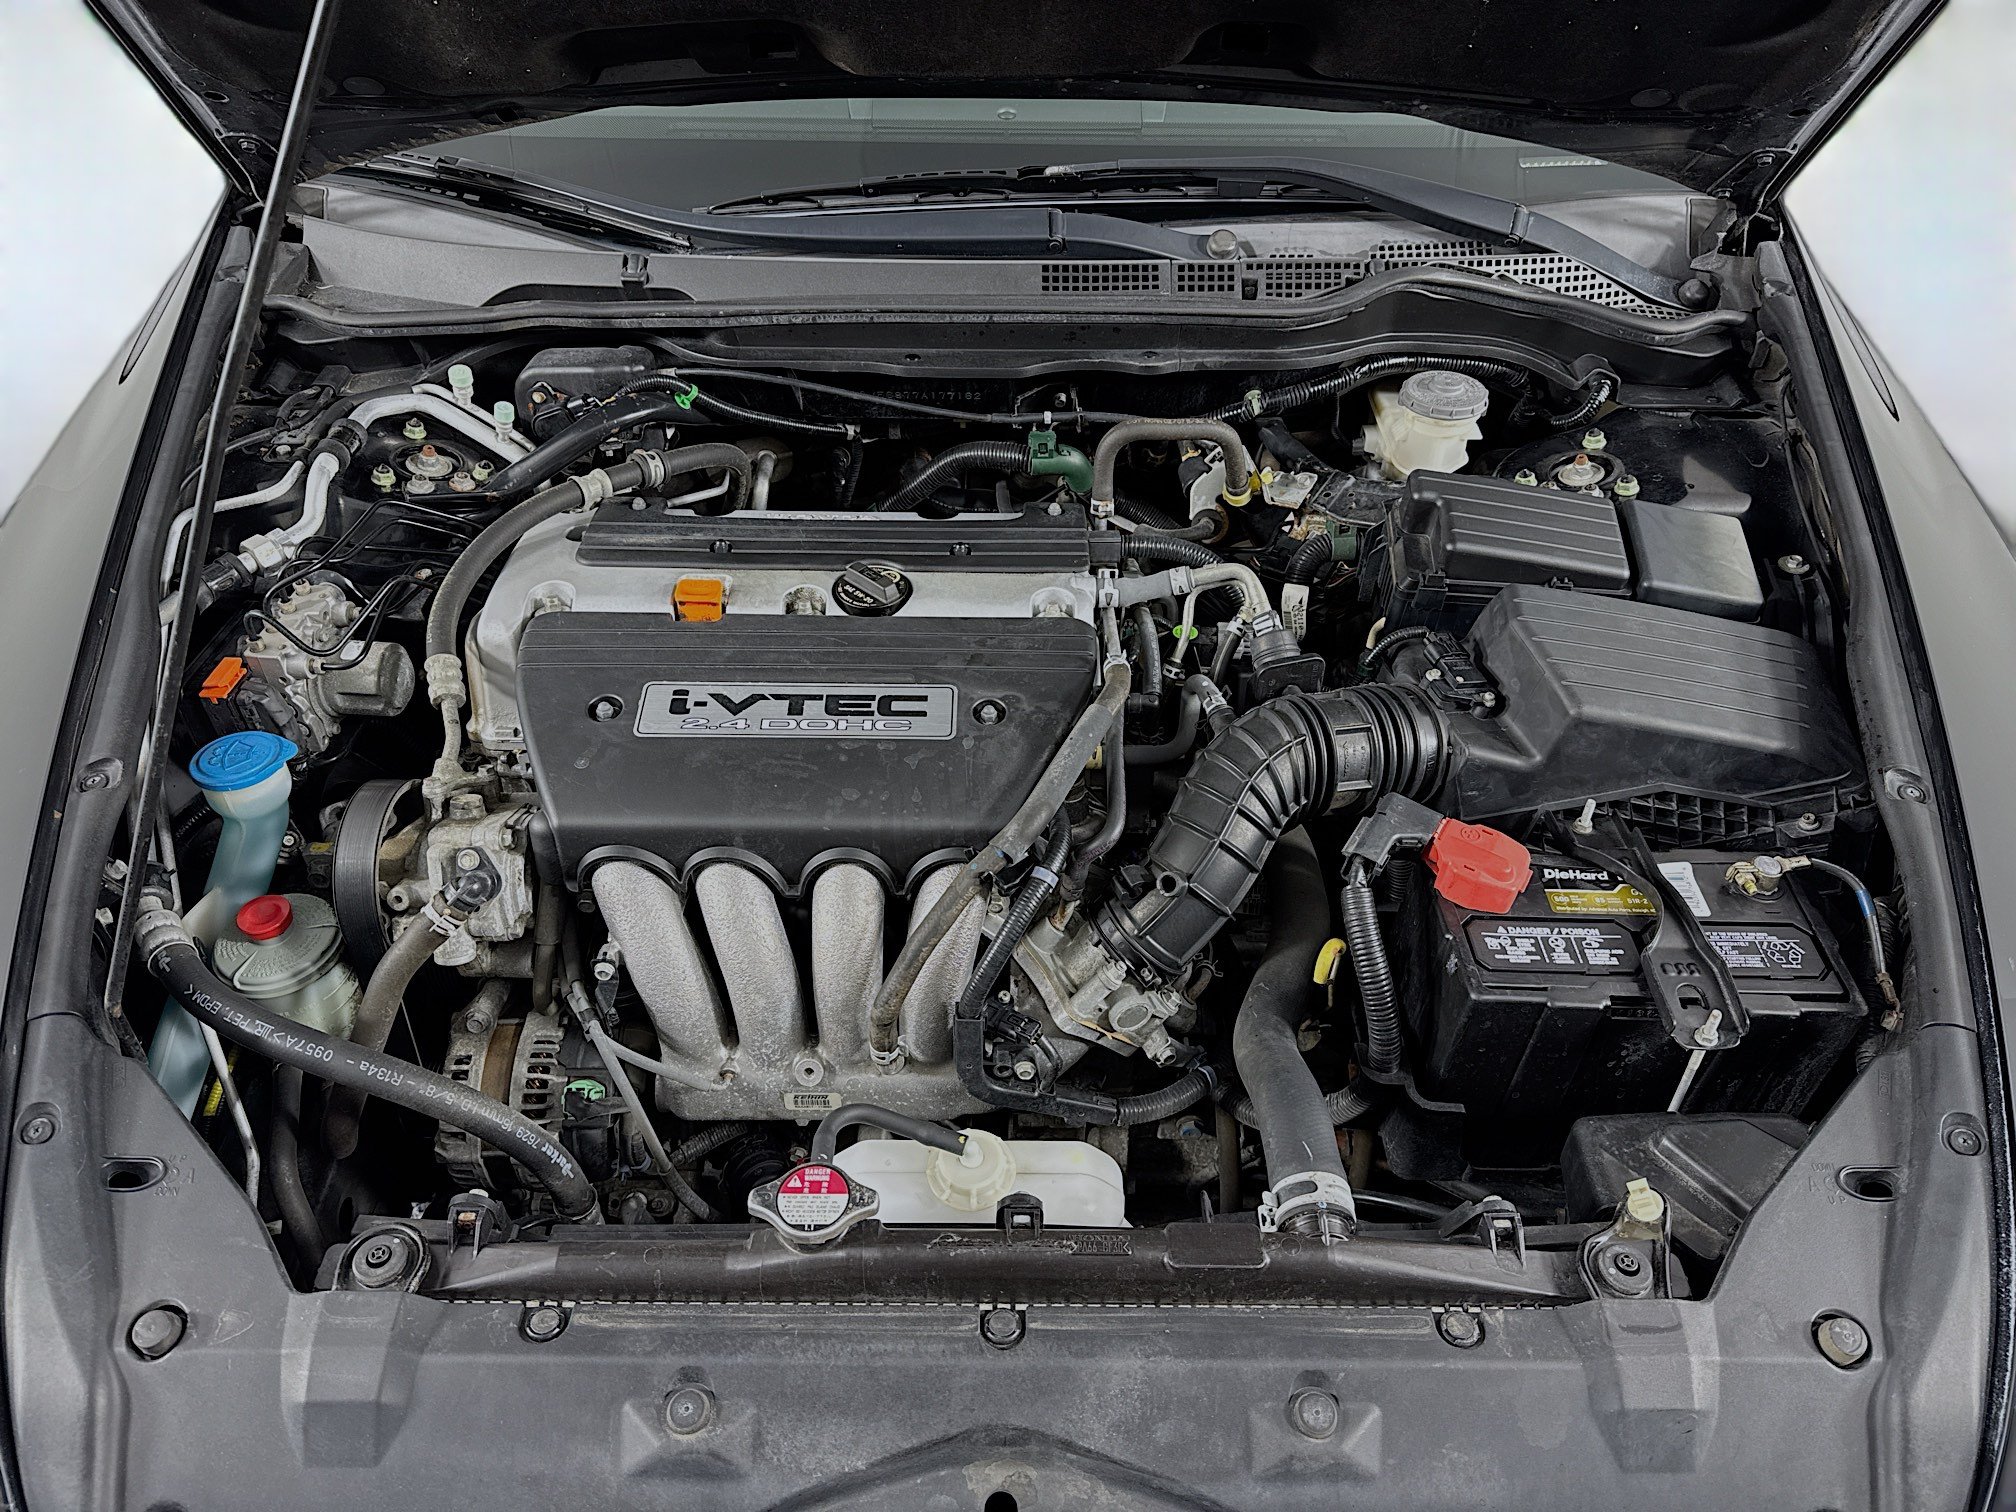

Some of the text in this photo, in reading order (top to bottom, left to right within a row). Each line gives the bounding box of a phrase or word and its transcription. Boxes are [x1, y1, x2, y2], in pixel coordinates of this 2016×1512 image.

[669, 688, 928, 717] i-VTEC
[681, 718, 912, 732] 2.4 DOHC
[1543, 868, 1609, 880] DieHard
[1507, 927, 1550, 935] DANGER
[1560, 927, 1600, 936] POISON
[359, 1060, 405, 1087] R134a
[482, 1106, 514, 1132] 16mm
[516, 1126, 540, 1149] 7629
[541, 1142, 574, 1179] Parker
